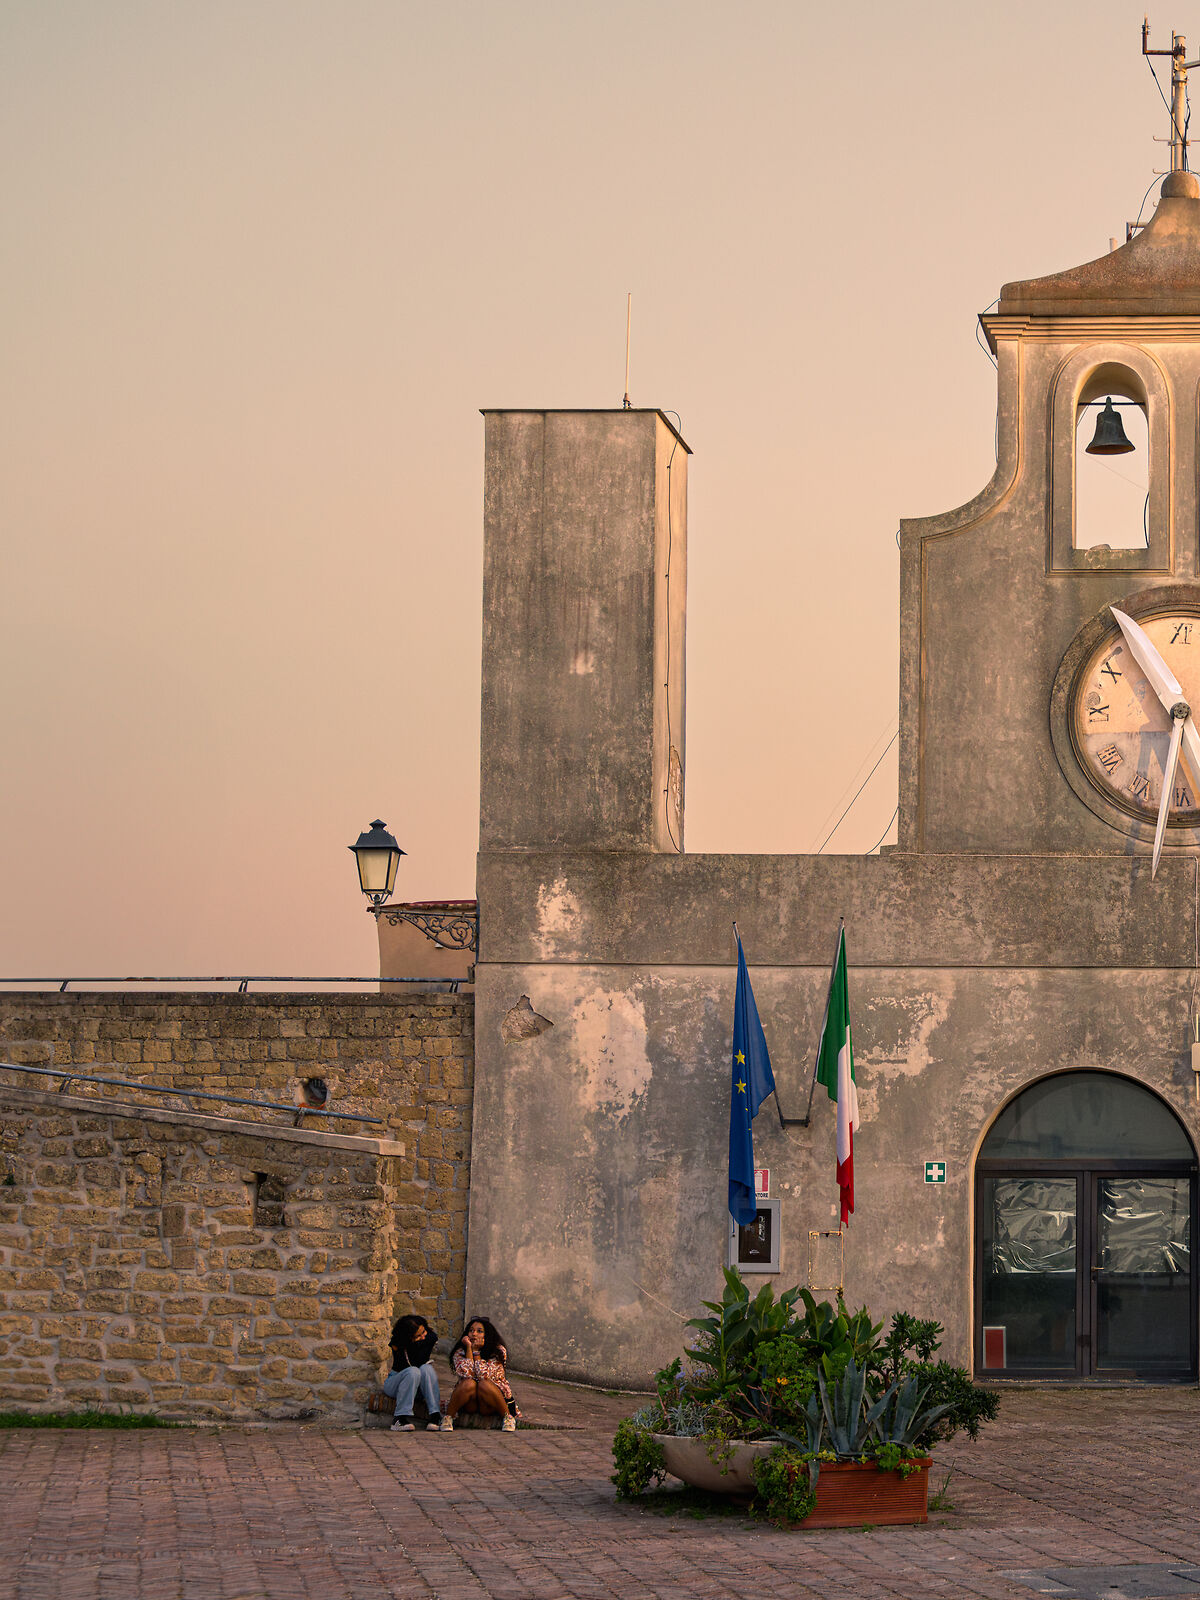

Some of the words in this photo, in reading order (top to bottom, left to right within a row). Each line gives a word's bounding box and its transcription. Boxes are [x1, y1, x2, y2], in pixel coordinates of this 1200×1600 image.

[1100, 661, 1123, 685] X
[1088, 704, 1110, 723] IX
[1175, 787, 1191, 807] VI
